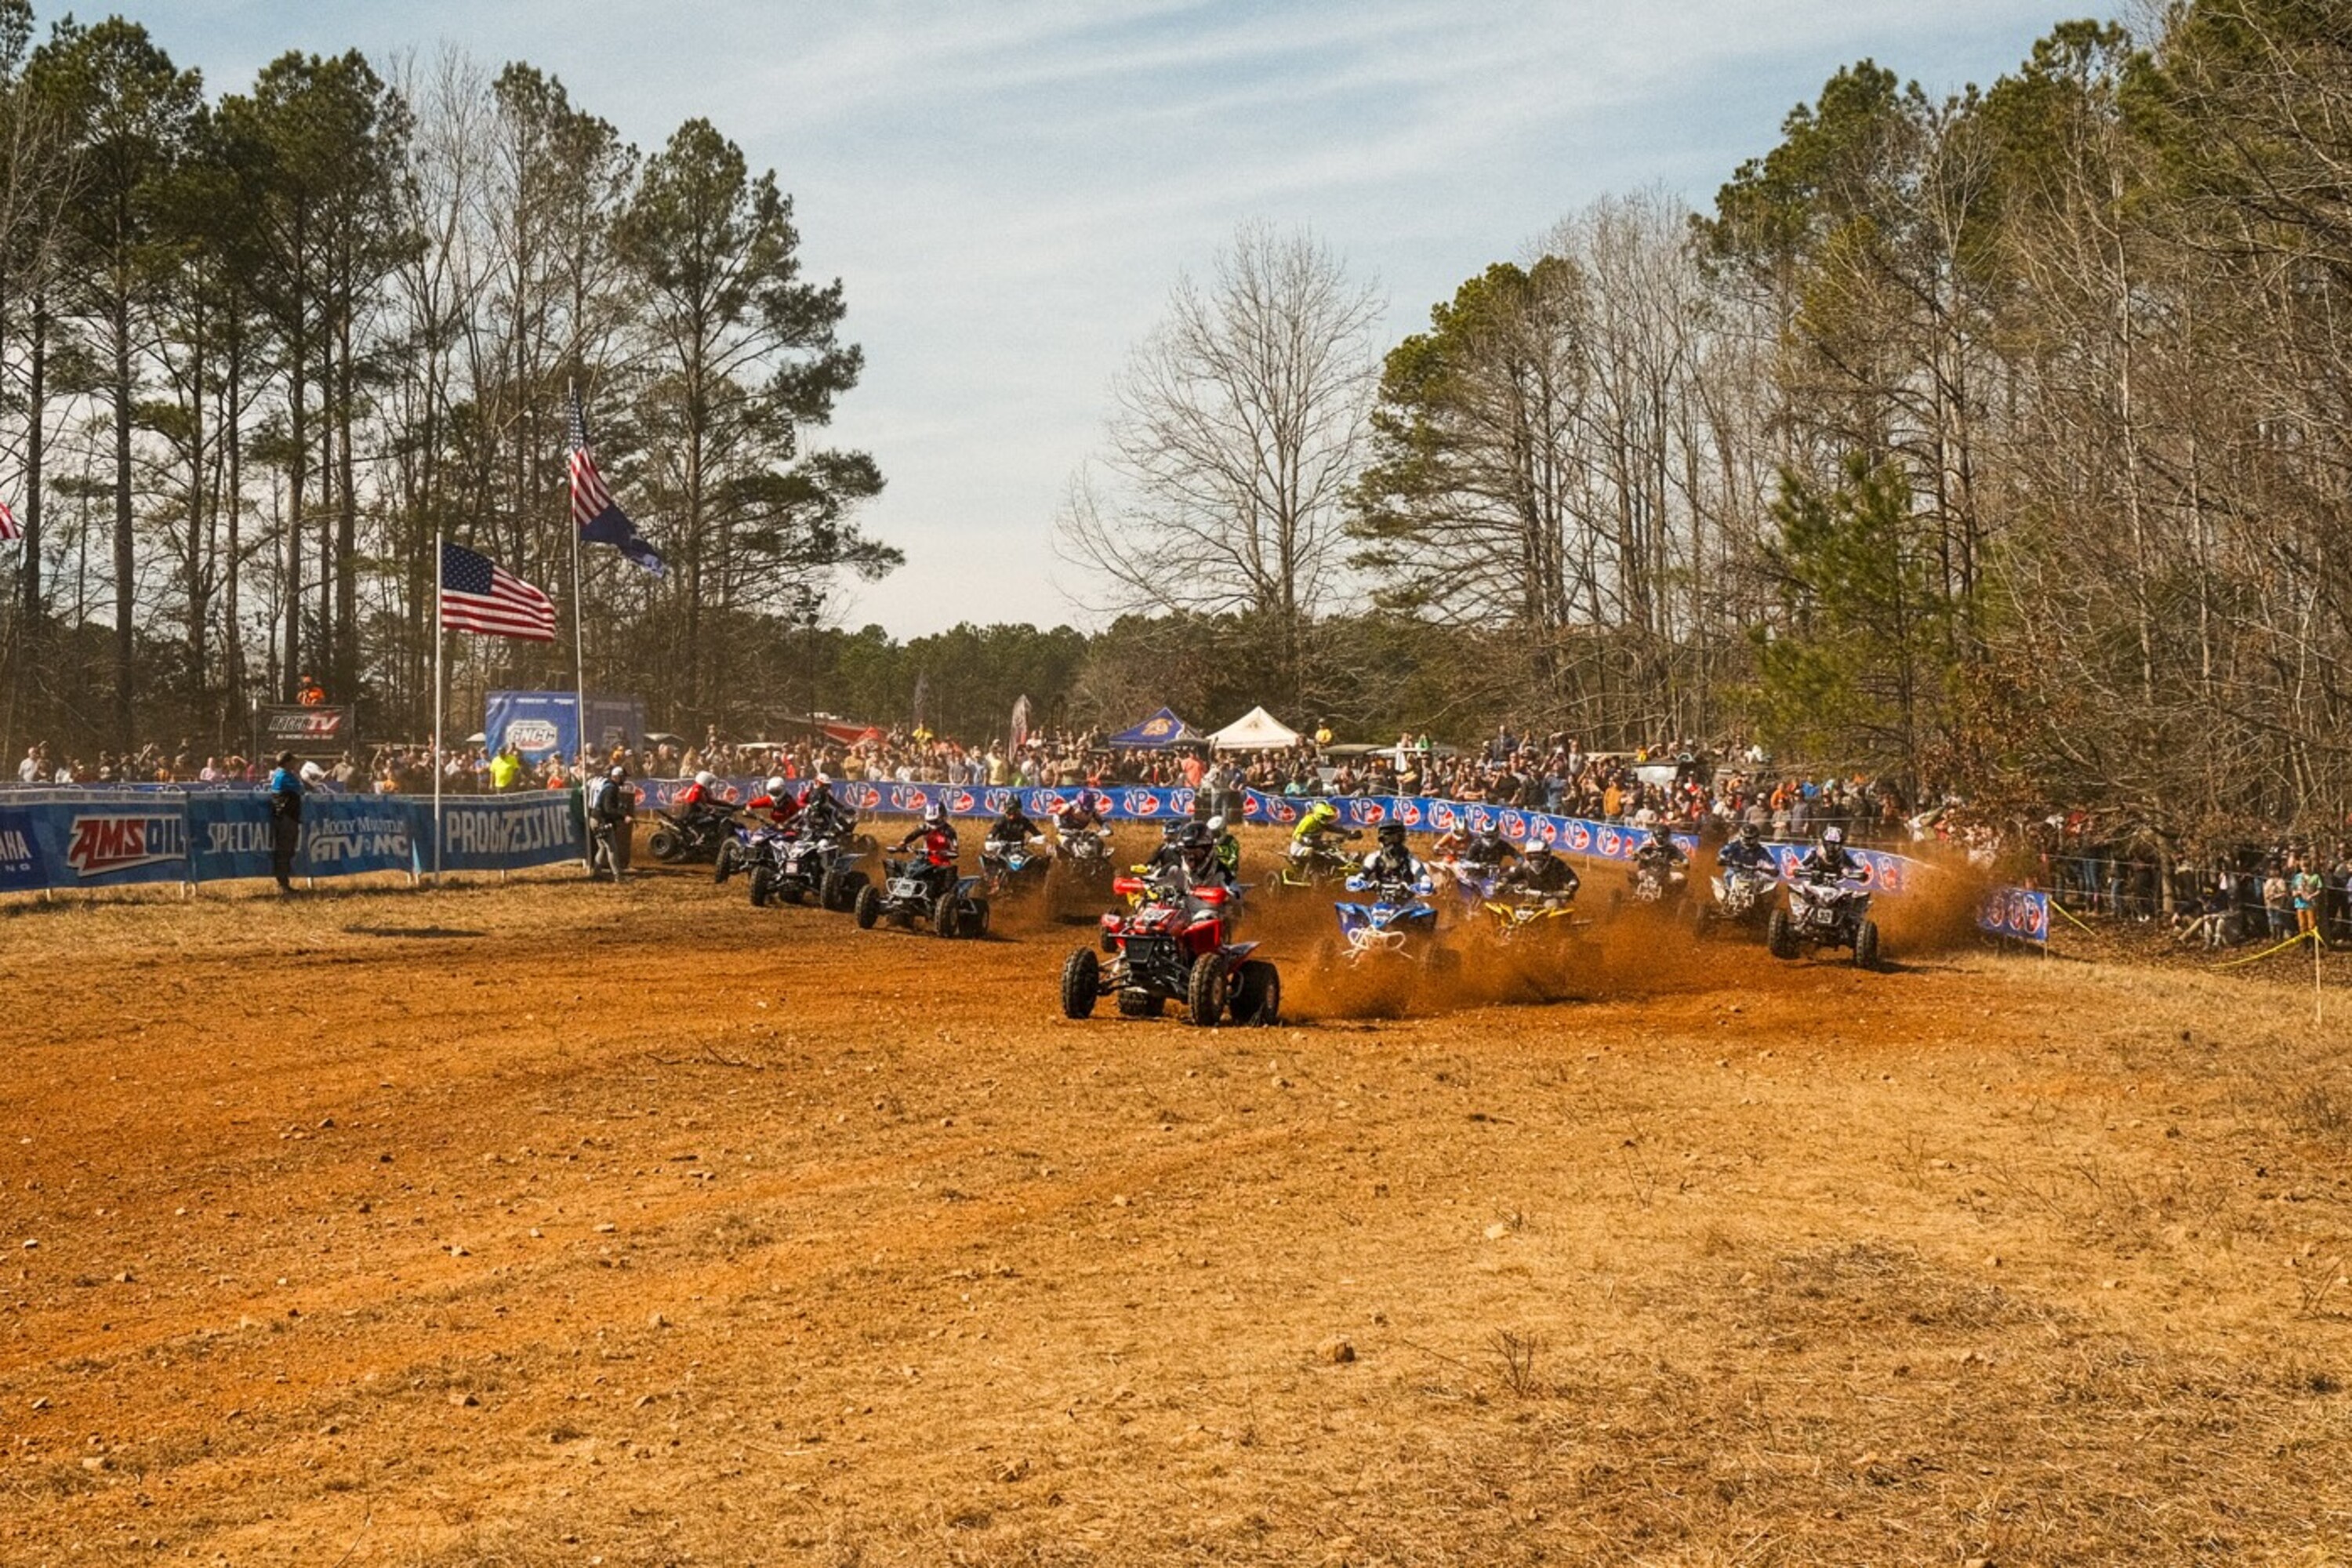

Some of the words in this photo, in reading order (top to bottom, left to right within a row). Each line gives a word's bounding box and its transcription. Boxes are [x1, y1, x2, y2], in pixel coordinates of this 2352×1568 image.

[1124, 789, 1150, 814] VP
[1172, 788, 1195, 814] VP
[1349, 798, 1374, 823] VP
[446, 805, 575, 853] PROGRESSIVE
[69, 815, 186, 876] AMSOIL
